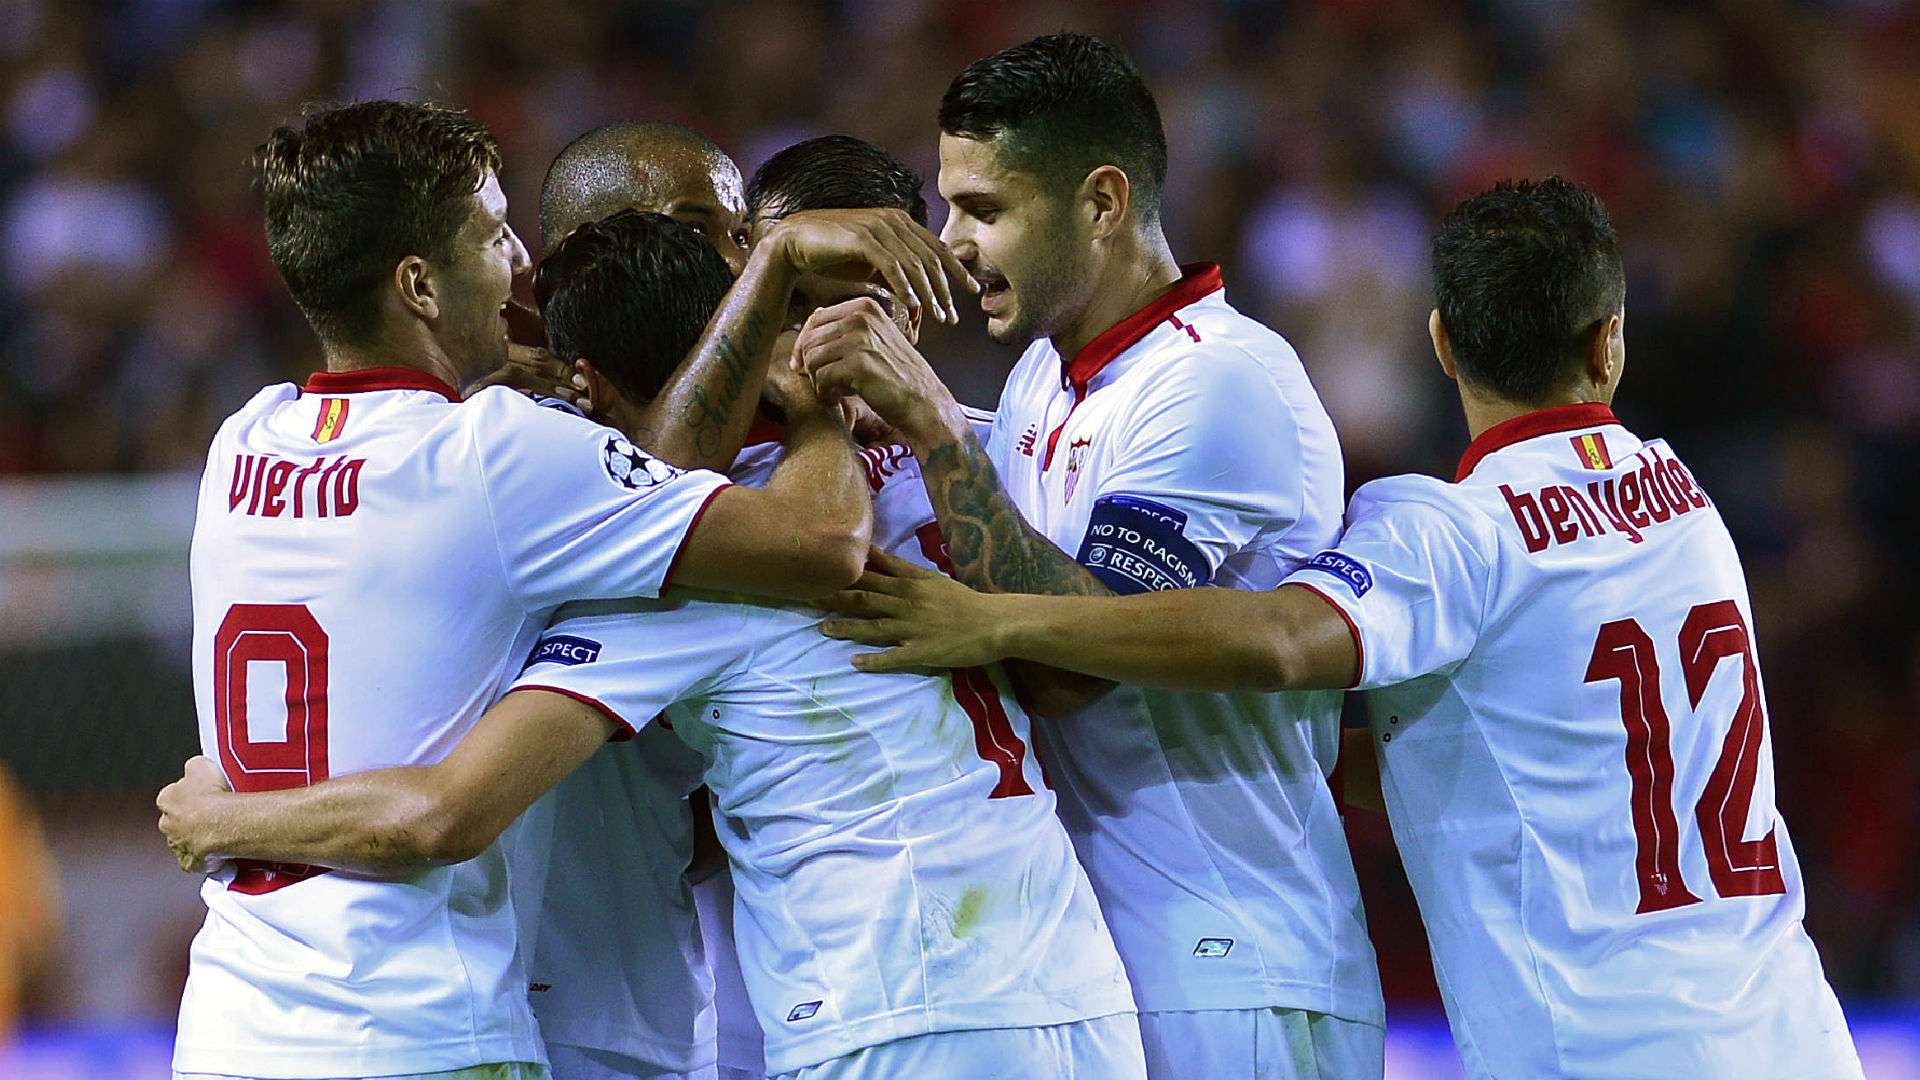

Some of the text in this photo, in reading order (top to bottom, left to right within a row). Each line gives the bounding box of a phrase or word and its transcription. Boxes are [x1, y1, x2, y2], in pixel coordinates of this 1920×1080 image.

[1587, 447, 1712, 544] yedde
[1090, 524, 1197, 589] NO TO RACISM
[1308, 554, 1369, 591] ESPECT
[539, 642, 597, 663] SPECT
[1583, 600, 1787, 914] 12
